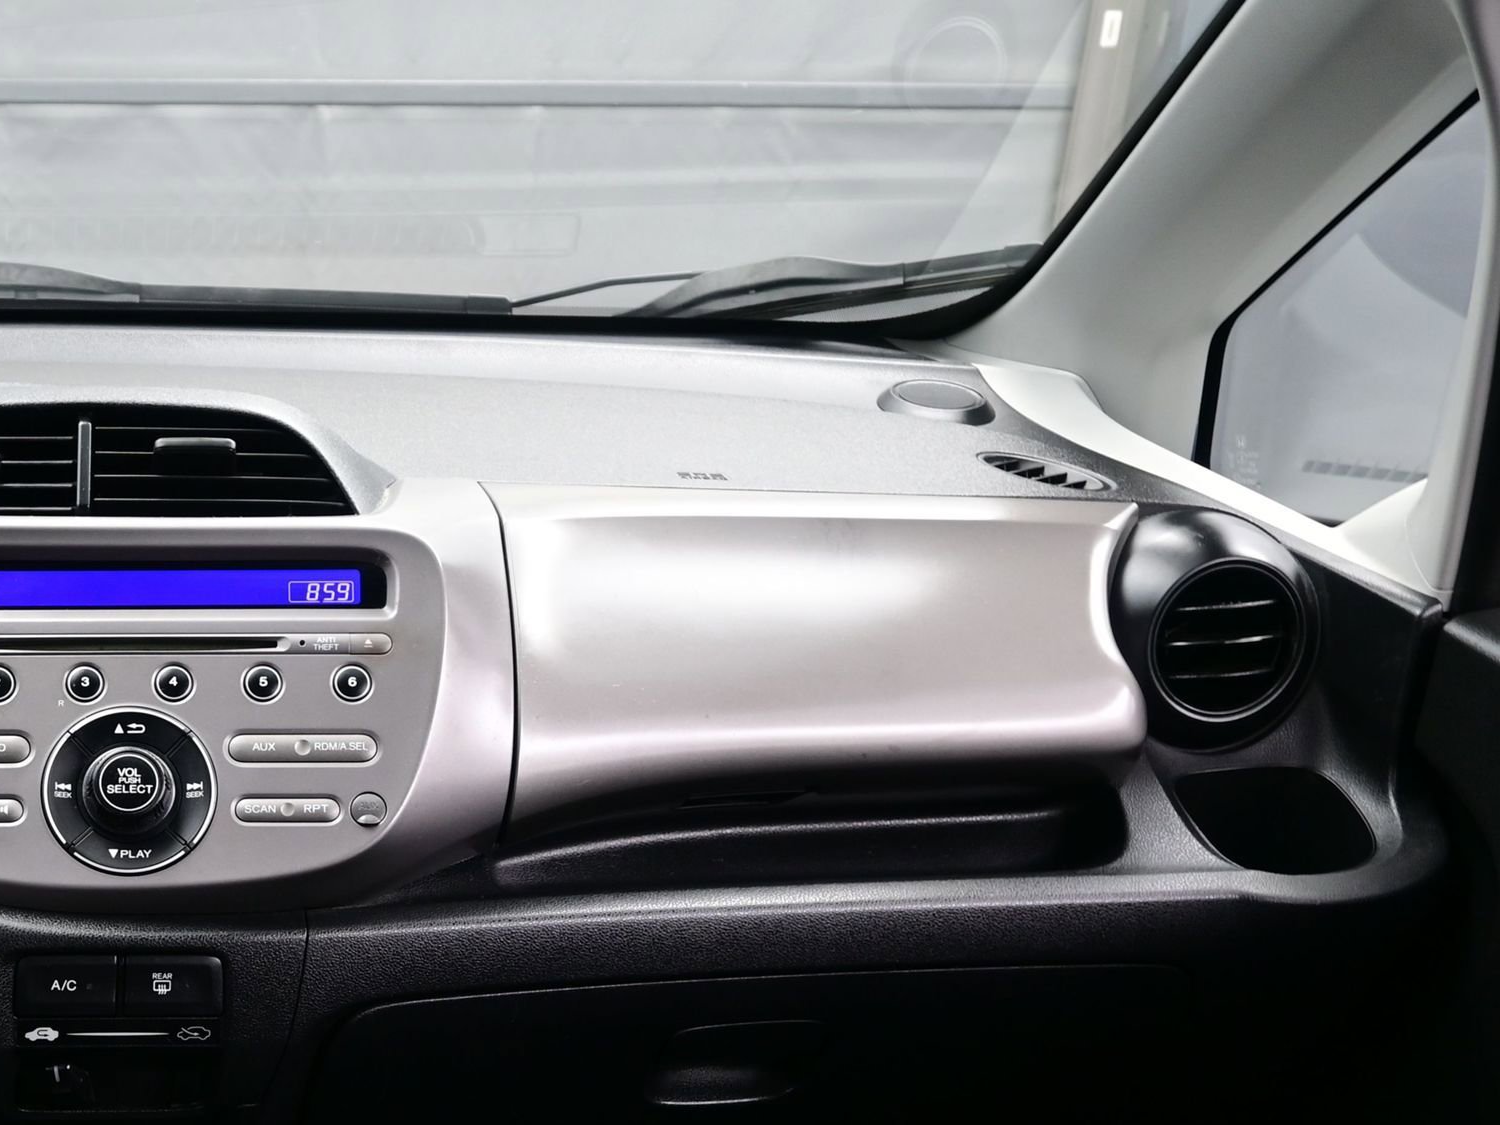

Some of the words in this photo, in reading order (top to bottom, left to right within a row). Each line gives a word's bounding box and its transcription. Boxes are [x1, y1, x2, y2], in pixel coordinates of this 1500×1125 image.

[80, 676, 90, 687] 3
[169, 676, 178, 687] 4
[259, 676, 268, 687] 5
[348, 676, 357, 687] 6
[252, 742, 276, 751] AUX
[117, 767, 141, 777] VOL
[106, 784, 153, 794] SELECT
[186, 791, 204, 799] SEEK
[245, 805, 277, 813] SCAN
[303, 804, 329, 813] RPT
[120, 850, 152, 858] PLAY
[51, 980, 77, 991] A/C
